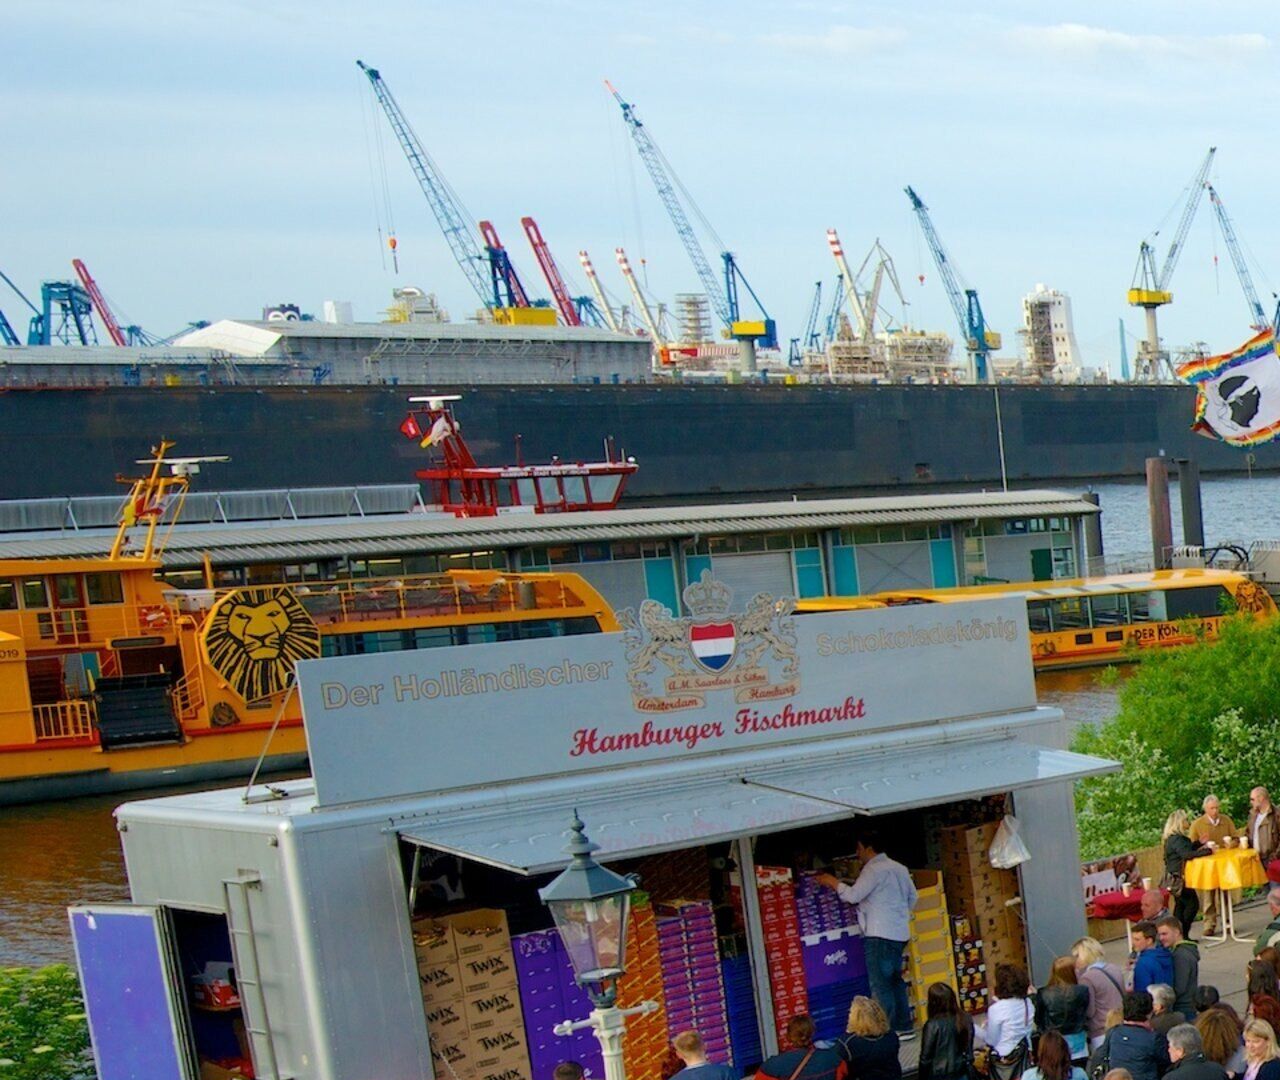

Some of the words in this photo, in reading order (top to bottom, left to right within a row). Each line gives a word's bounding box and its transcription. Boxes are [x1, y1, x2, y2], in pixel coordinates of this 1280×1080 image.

[815, 616, 1018, 657] Schokoladekönig
[321, 682, 384, 710] Der
[393, 658, 613, 702] Holländischer
[637, 698, 699, 711] Amsterdam
[570, 720, 724, 757] Hamburger
[734, 696, 866, 734] Fischmarkt
